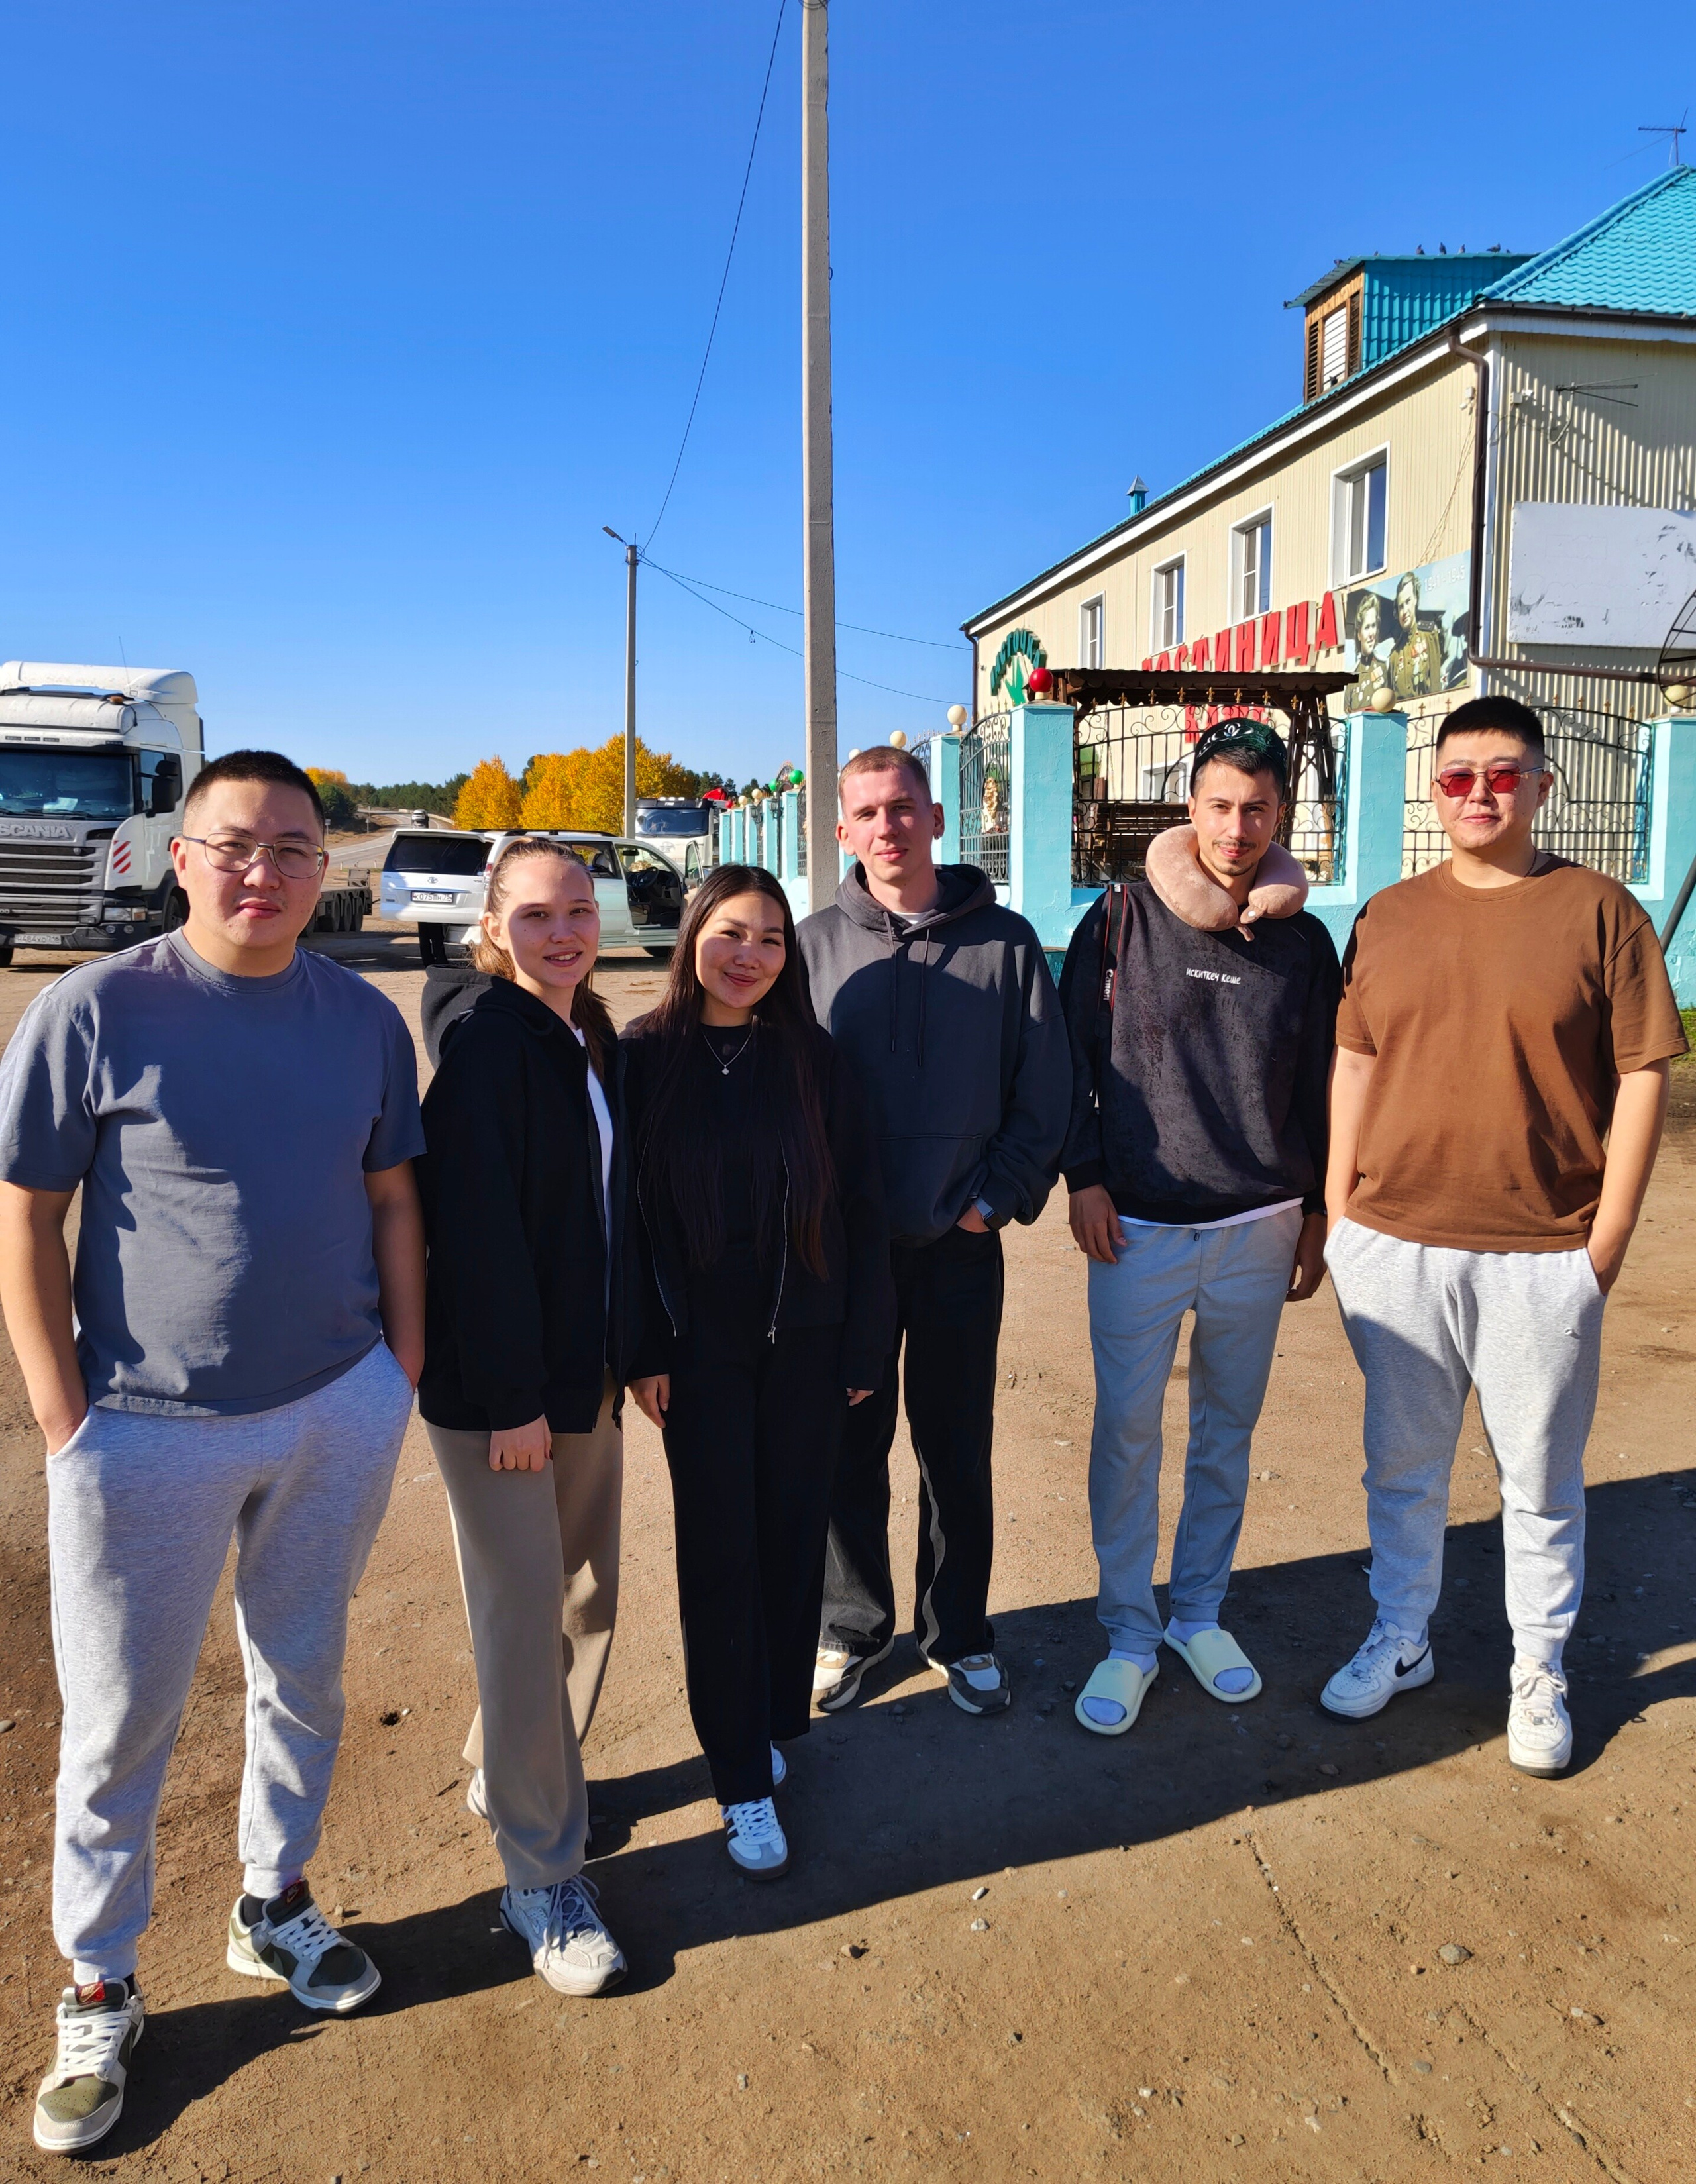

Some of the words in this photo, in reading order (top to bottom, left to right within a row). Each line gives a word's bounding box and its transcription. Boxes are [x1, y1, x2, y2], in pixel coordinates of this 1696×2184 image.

[1424, 574, 1440, 592] 1941
[0, 824, 70, 838] SCANIA
[1103, 968, 1114, 1000] Canon
